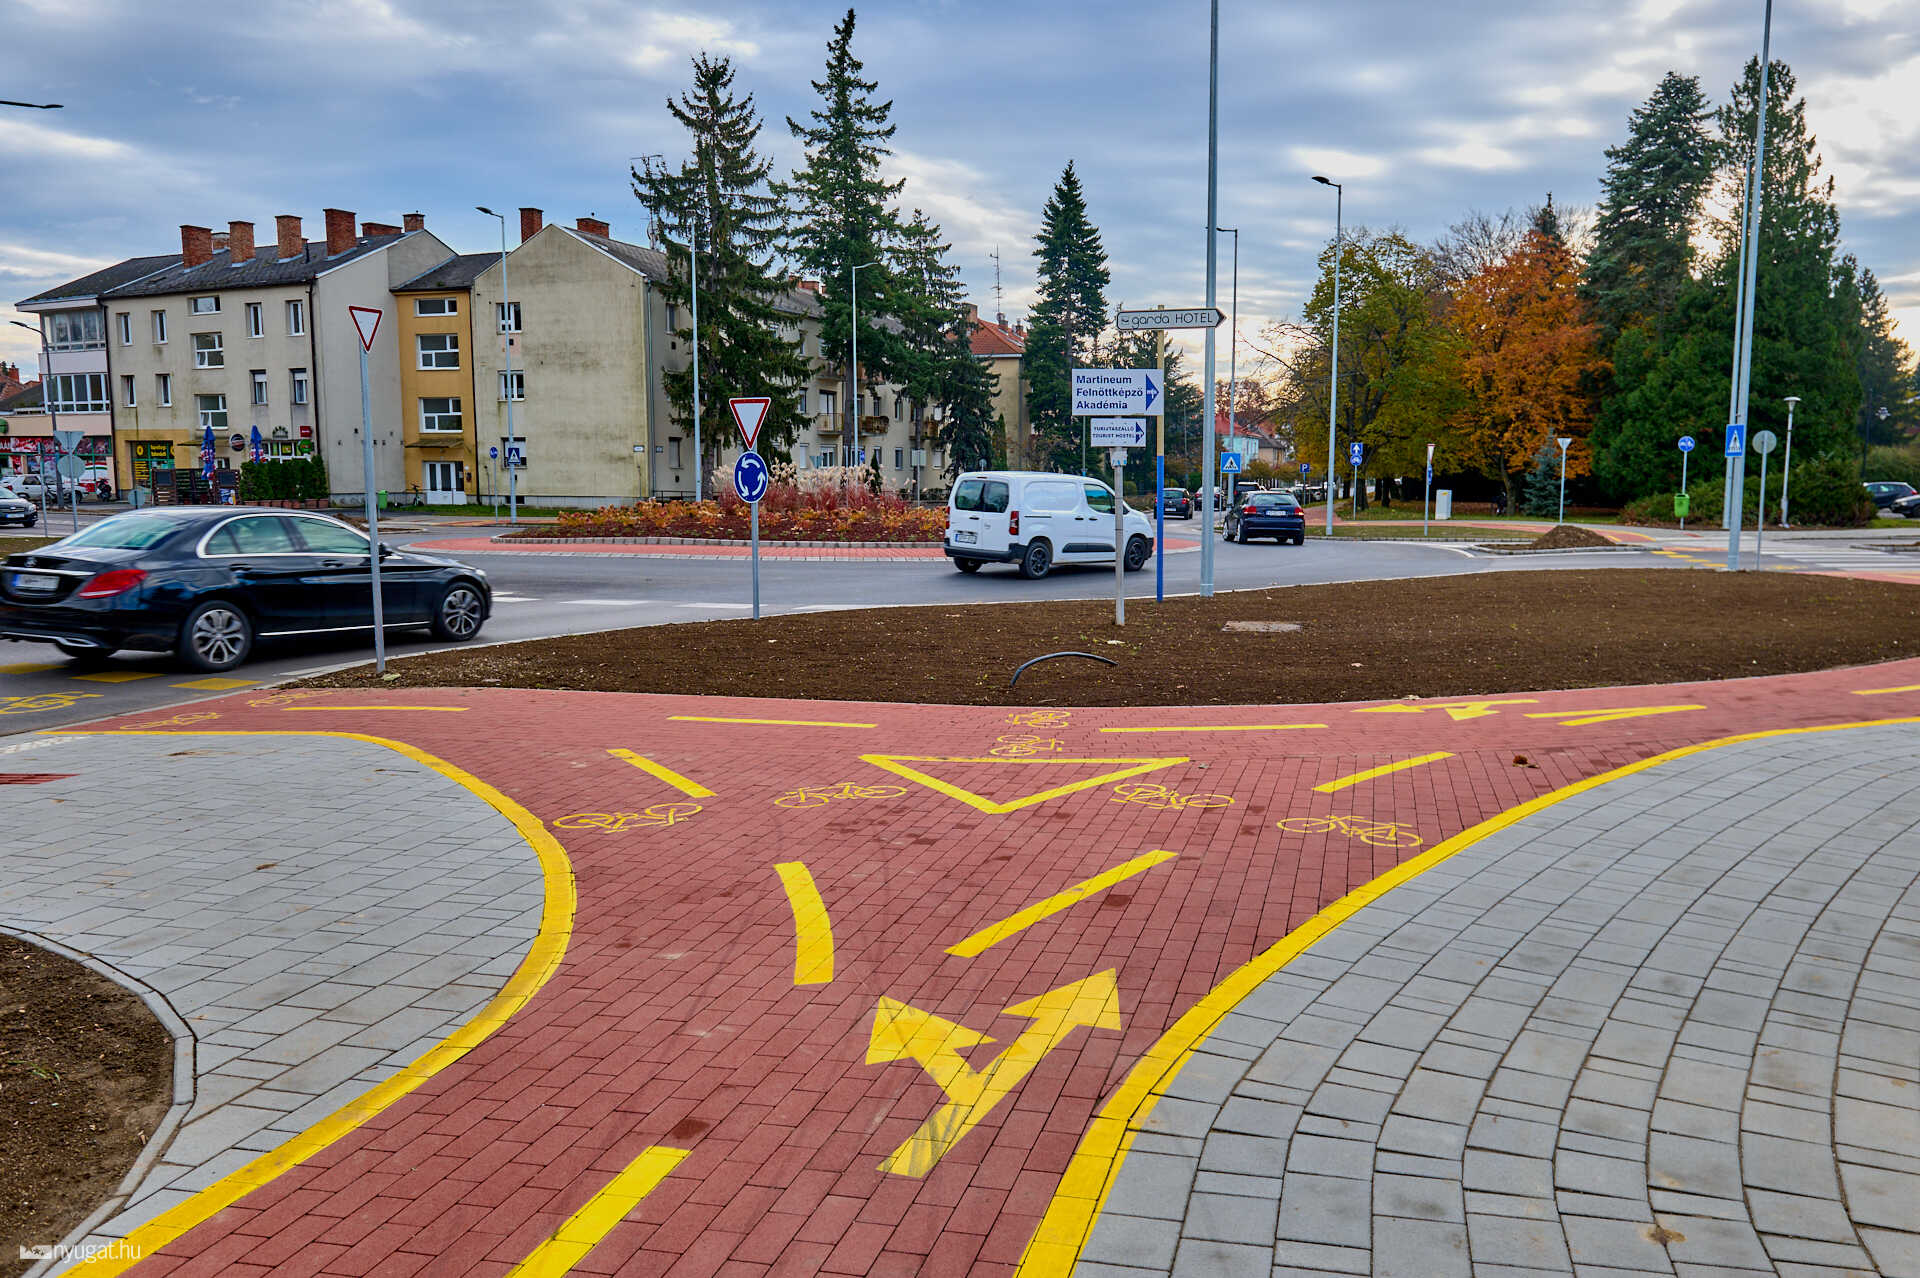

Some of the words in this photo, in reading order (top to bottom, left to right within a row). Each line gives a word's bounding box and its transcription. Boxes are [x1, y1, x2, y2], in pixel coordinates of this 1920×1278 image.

[1175, 313, 1213, 324] HOTEL
[1076, 375, 1132, 384] Martineum
[1076, 400, 1128, 409] Akadémia
